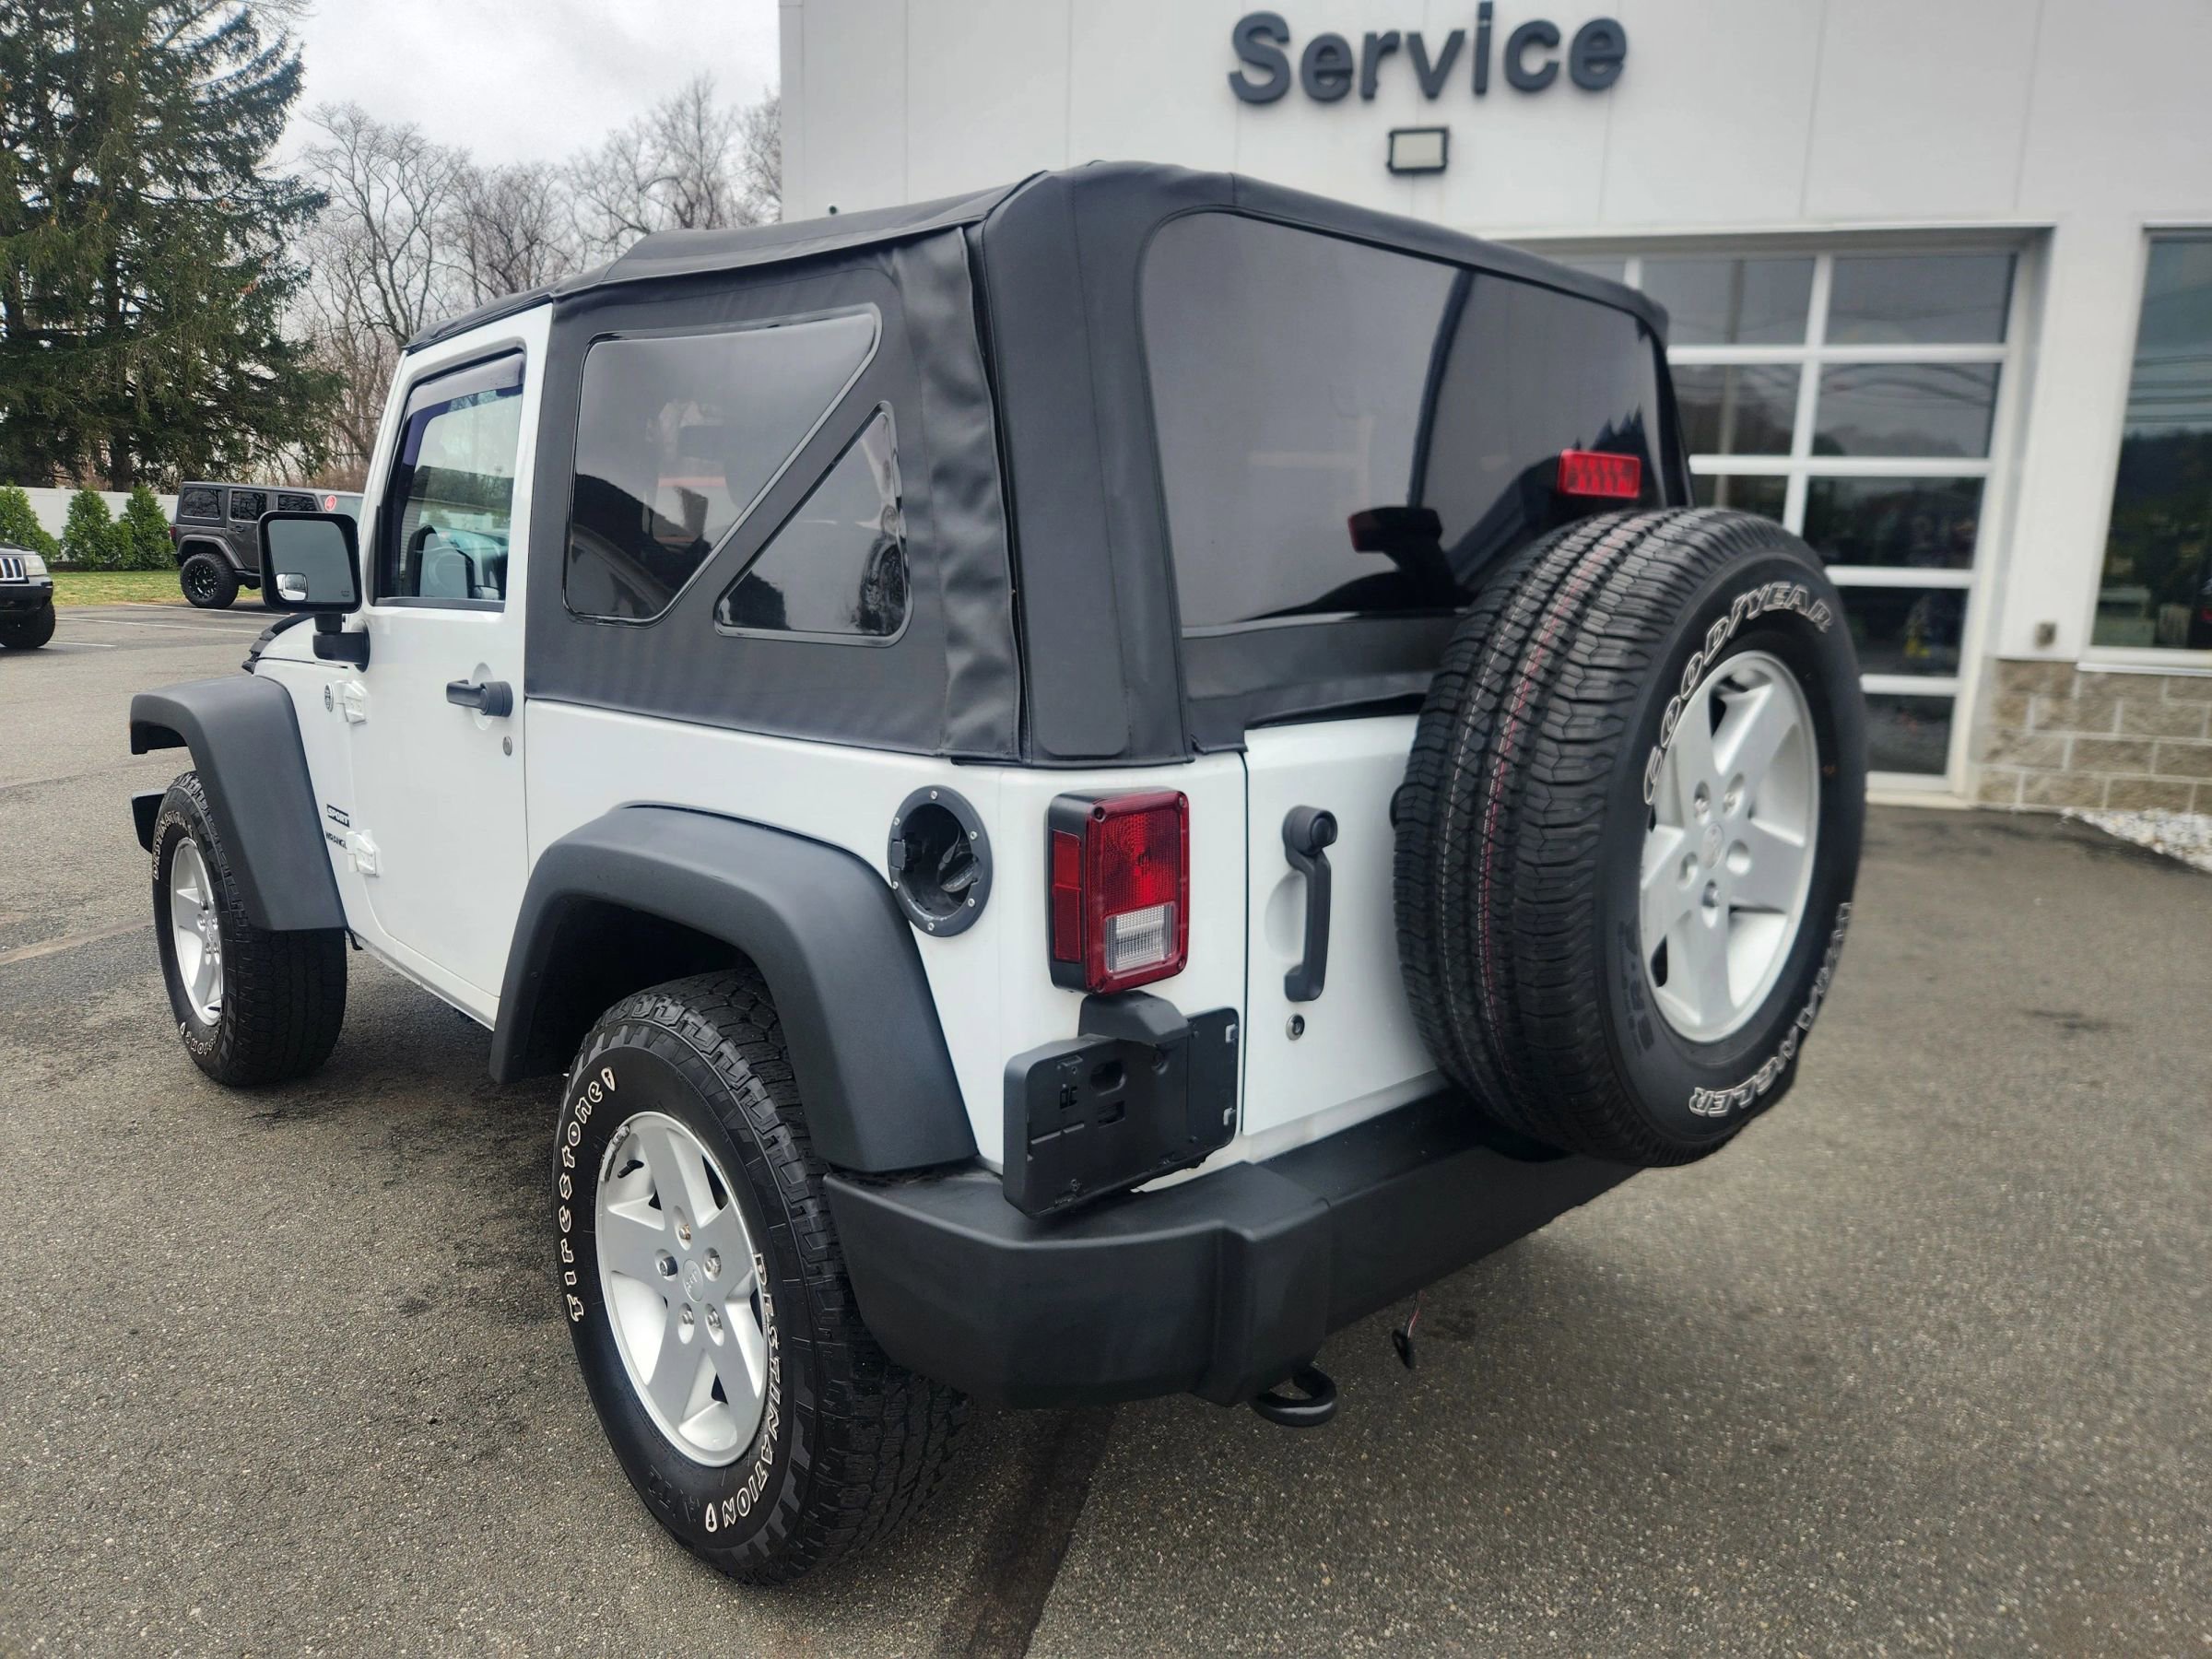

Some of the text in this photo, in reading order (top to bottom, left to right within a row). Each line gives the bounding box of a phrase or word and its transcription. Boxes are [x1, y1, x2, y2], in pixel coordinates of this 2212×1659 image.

[1228, 2, 1627, 104] Service
[325, 831, 347, 850] WRANGL
[327, 806, 349, 826] SPORT
[559, 1080, 603, 1322] Firestone
[723, 1253, 781, 1529] DESTINATION
